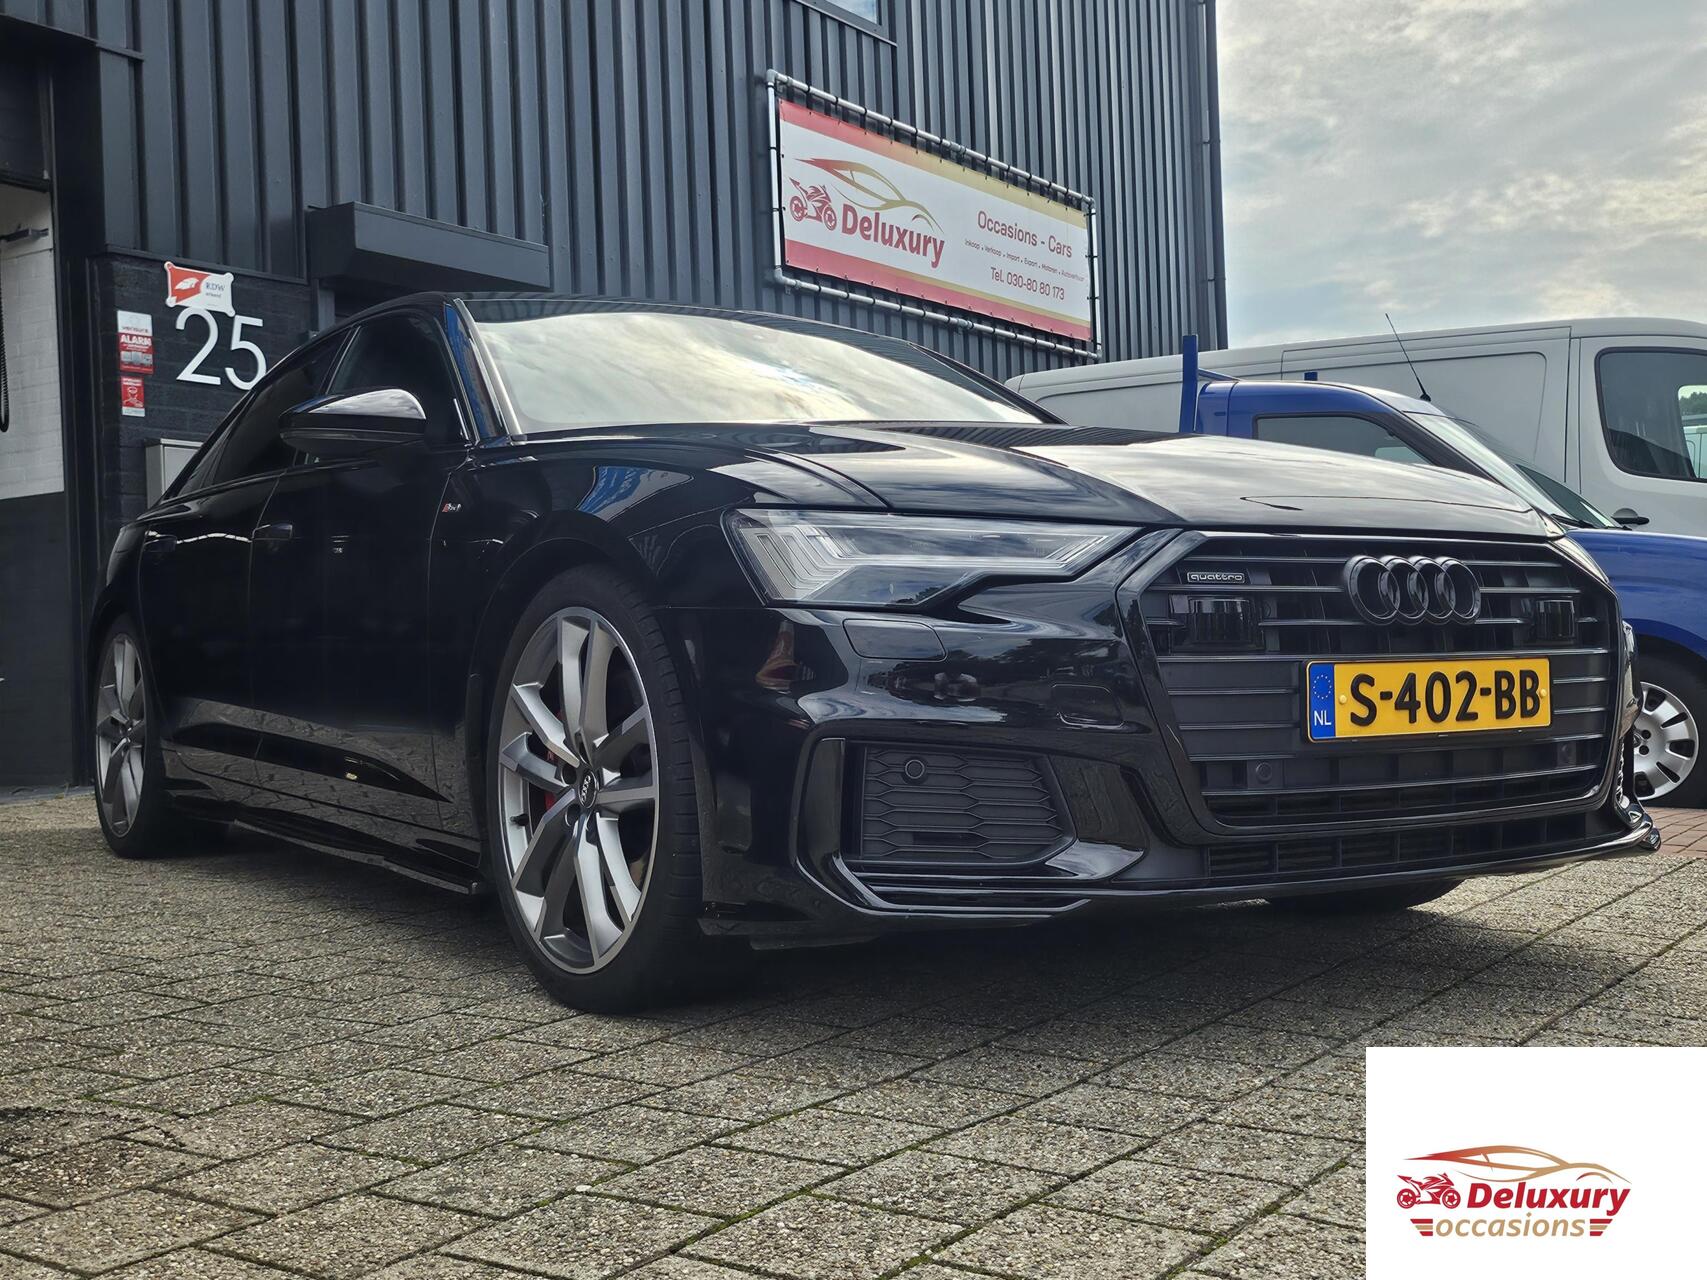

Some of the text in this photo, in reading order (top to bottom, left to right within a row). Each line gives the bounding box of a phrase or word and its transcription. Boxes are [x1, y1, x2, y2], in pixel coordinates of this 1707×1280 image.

[841, 203, 945, 269] Deluxury
[977, 210, 1038, 247] Occasions
[1048, 235, 1073, 258] Cars
[1006, 271, 1038, 293] 030-80
[1039, 281, 1051, 296] 80
[1052, 286, 1065, 301] 173
[120, 334, 152, 346] ALARM
[175, 306, 267, 391] 25
[1190, 574, 1243, 582] quattro
[1350, 669, 1541, 727] S-402-BB
[1313, 710, 1332, 726] NL
